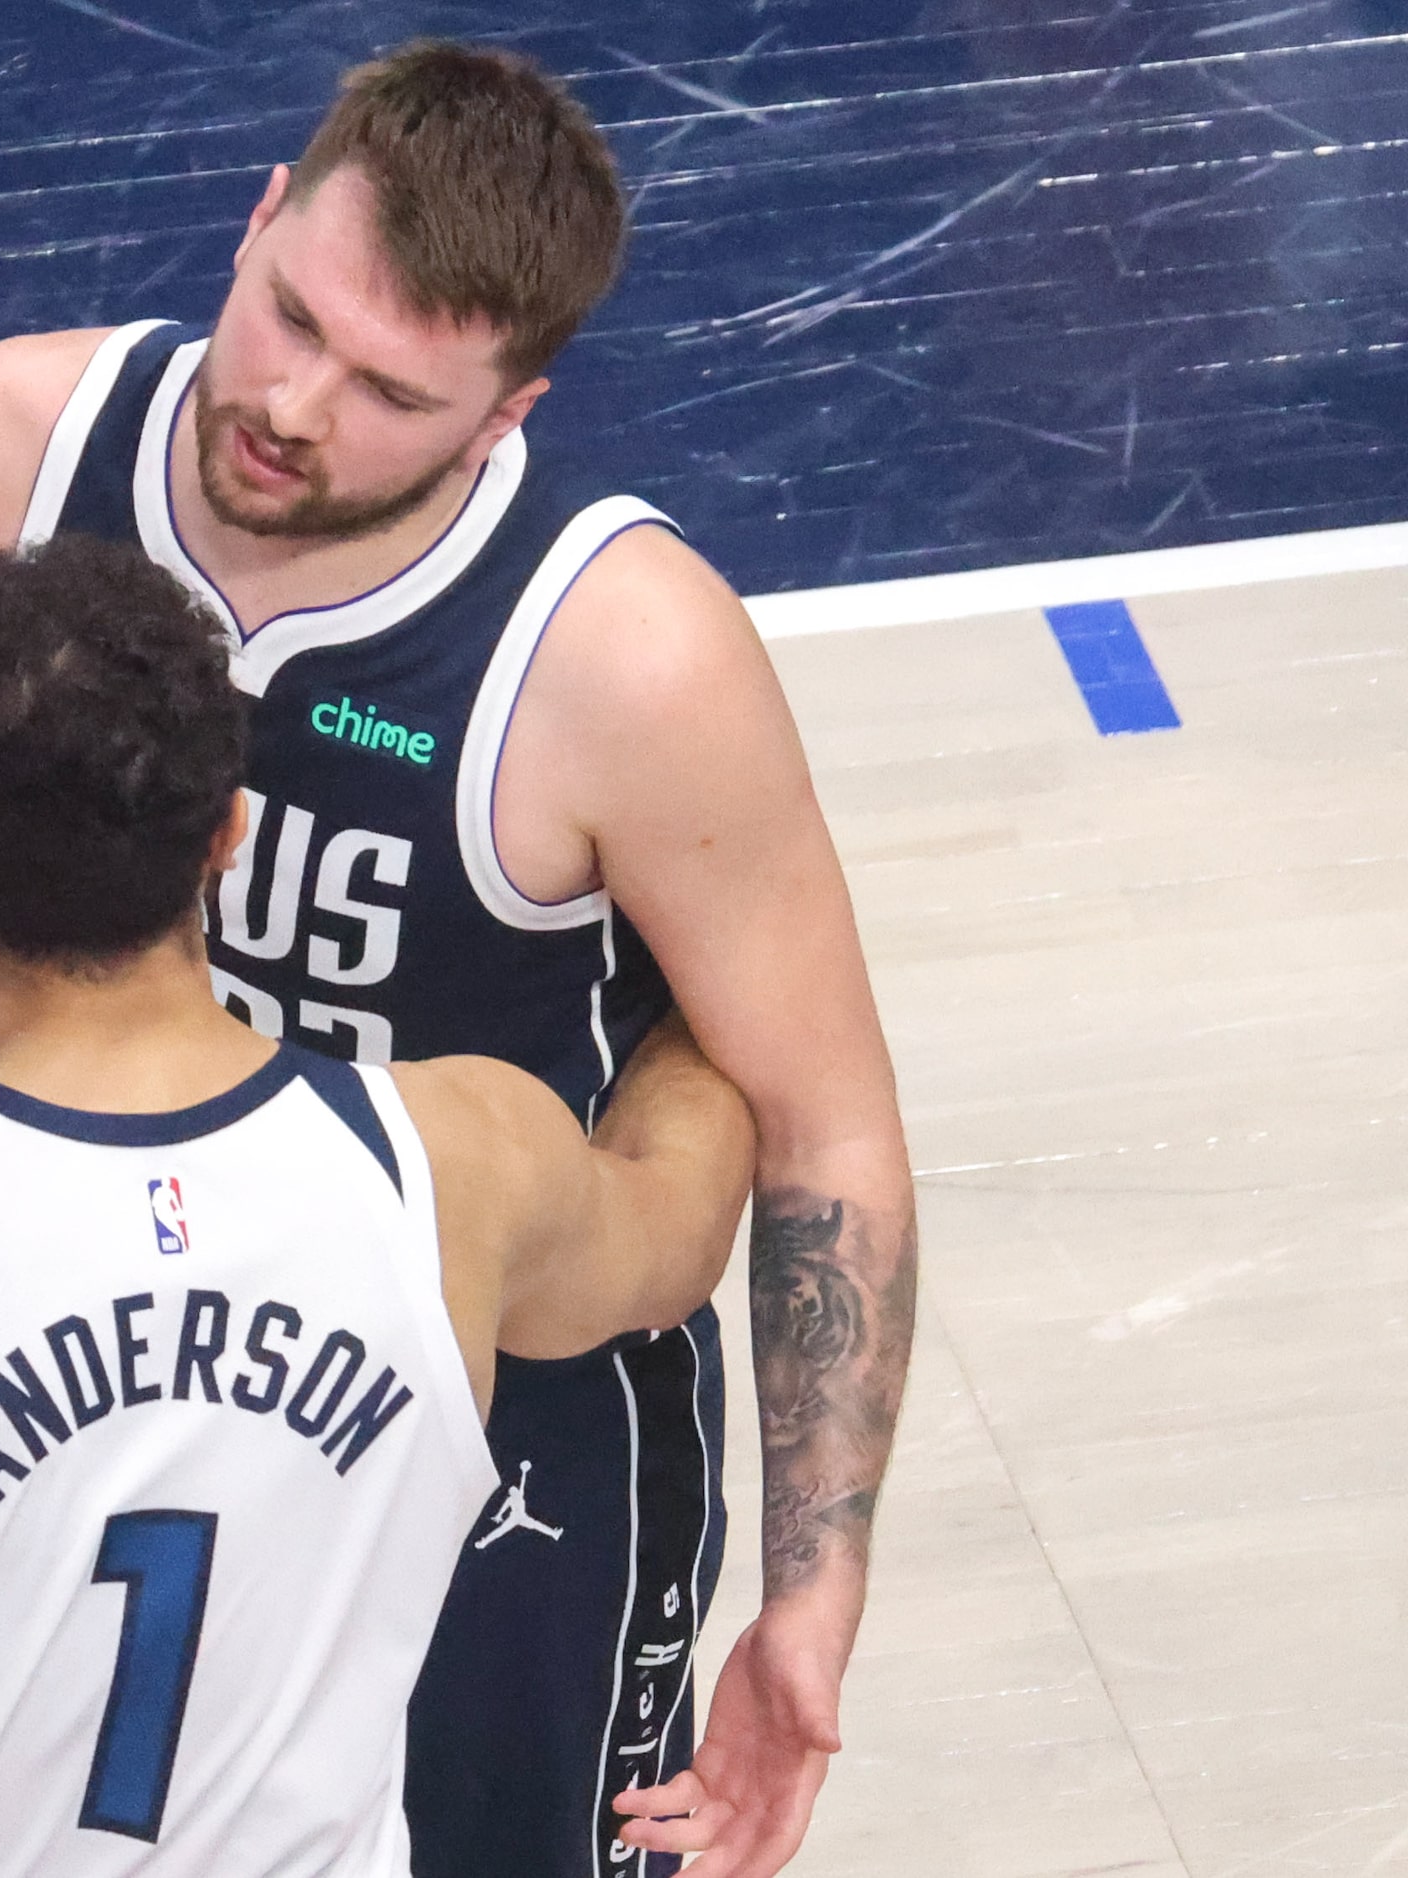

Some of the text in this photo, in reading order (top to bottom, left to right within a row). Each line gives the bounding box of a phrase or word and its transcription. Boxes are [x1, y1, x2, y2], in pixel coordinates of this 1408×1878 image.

[311, 697, 436, 765] chime
[203, 786, 413, 987] US
[78, 1508, 219, 1844] 1
